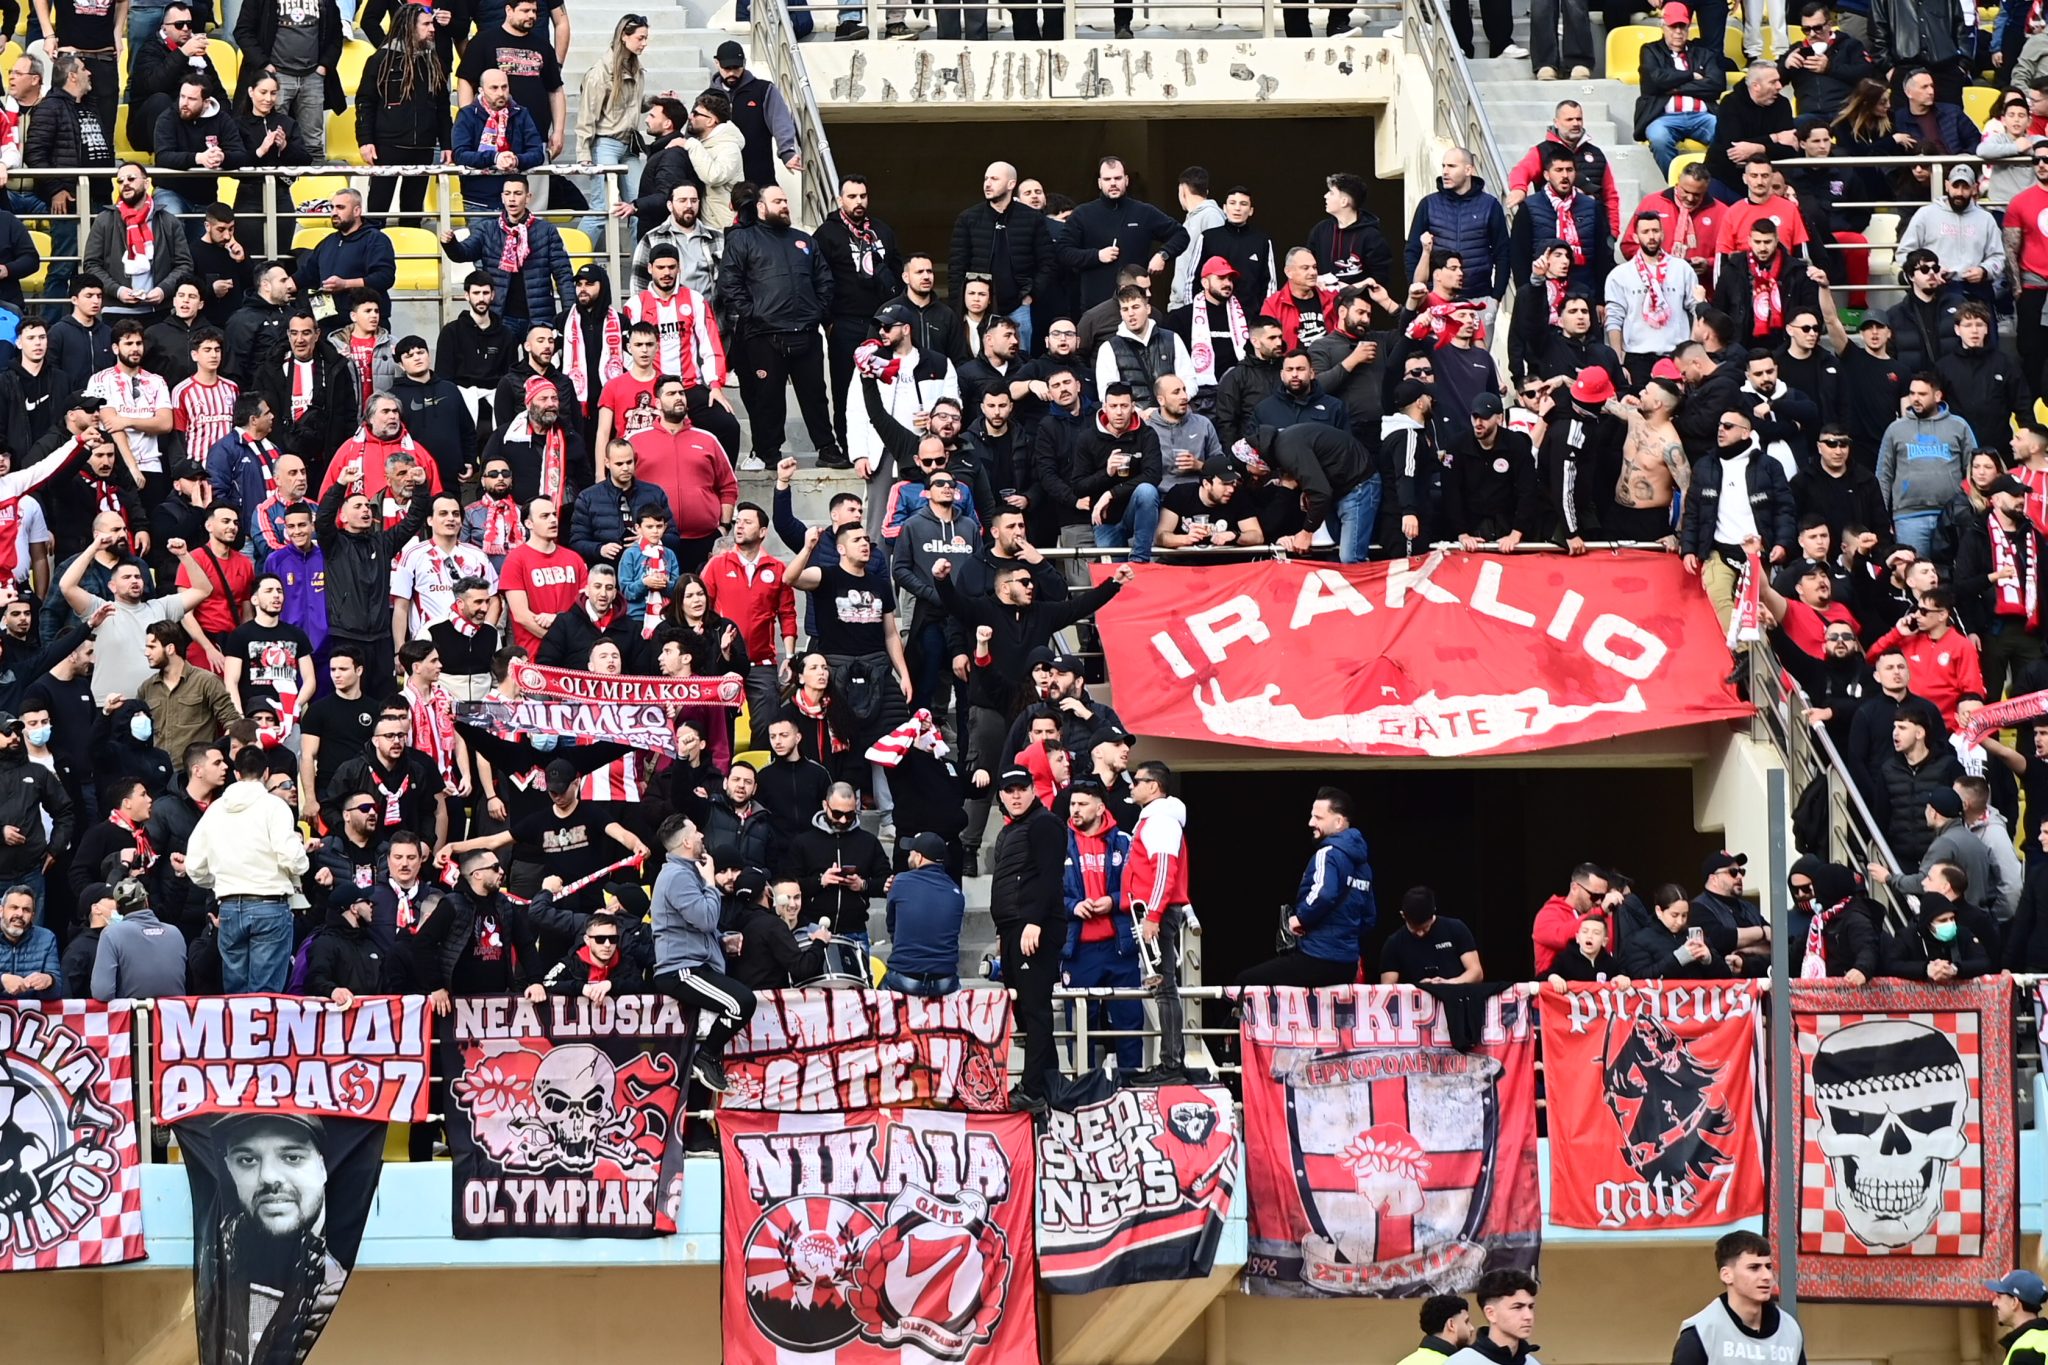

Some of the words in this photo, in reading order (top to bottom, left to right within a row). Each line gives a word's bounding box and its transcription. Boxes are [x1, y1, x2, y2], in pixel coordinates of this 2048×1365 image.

[1905, 443, 1952, 460] LONSDALE
[923, 539, 973, 554] ellesse
[429, 583, 453, 593] Stoix
[531, 566, 576, 587] ΘΗΒΑ
[1151, 549, 1668, 680] IRAKLIO
[559, 676, 701, 700] OLYMPIAKOS
[1379, 708, 1490, 739] GATE
[1514, 706, 1539, 729] 7
[158, 995, 425, 1062] ΜΕΝΙΔΙ
[455, 997, 542, 1038] NEA
[552, 995, 686, 1036] LIOSIA
[1567, 977, 1751, 1033] piraeus
[160, 1062, 340, 1120] ΘΥΡΑ
[383, 1062, 424, 1123] 7
[762, 1041, 915, 1111] GATE
[929, 1037, 962, 1099] 7
[1050, 1090, 1141, 1152] RED
[738, 1124, 1008, 1199] NIKAIA
[1042, 1125, 1164, 1182] SICK
[915, 1196, 963, 1225] GATE
[1041, 1159, 1178, 1226] NESS
[1595, 1177, 1697, 1227] gate
[1709, 1162, 1736, 1215] 7
[906, 1233, 971, 1324] 7
[1312, 1243, 1467, 1284] ΣΤΡΑΤΙΑ
[1723, 1341, 1766, 1361] BALL
[1769, 1344, 1795, 1363] BOY
